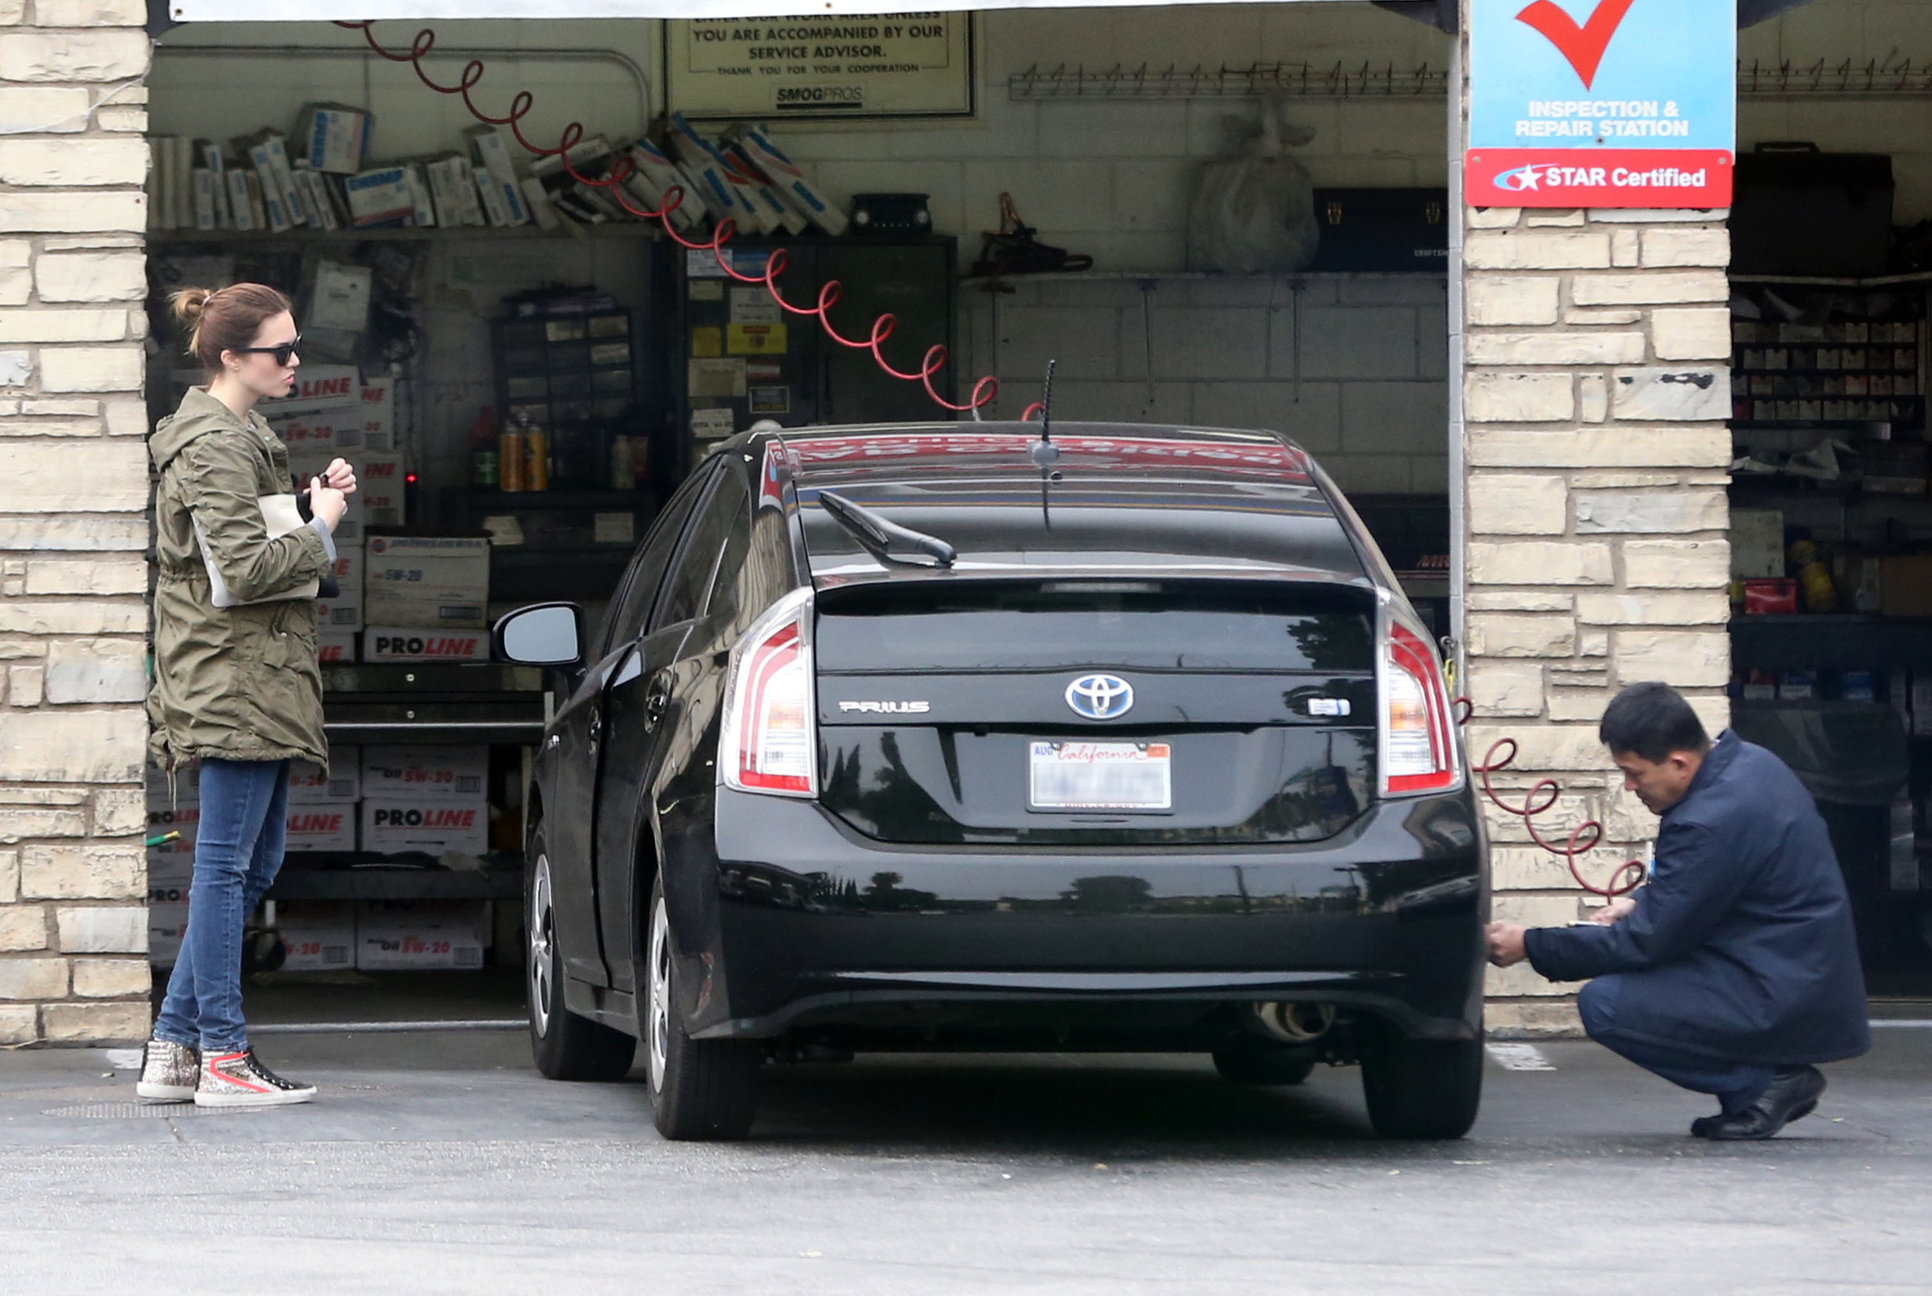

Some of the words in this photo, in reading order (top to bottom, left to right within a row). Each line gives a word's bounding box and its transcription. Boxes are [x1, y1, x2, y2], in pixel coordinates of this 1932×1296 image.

[693, 29, 727, 42] YOU
[732, 28, 761, 41] ARE
[766, 26, 879, 41] ACCOMPANIED
[884, 25, 904, 39] BY
[908, 24, 943, 38] OUR
[749, 46, 808, 60] SERVICE
[814, 44, 888, 59] ADVISOR.
[717, 66, 753, 76] THANK
[759, 66, 781, 75] YOU
[787, 65, 807, 74] FOR
[814, 64, 842, 74] YOUR
[847, 63, 919, 74] COOPERATION
[776, 87, 863, 102] SMOGPROS
[1528, 100, 1659, 118] INSPECTION
[1663, 100, 1680, 118] &
[1515, 120, 1593, 137] REPAIR
[1599, 119, 1690, 137] STATION
[1545, 166, 1607, 187] STAR
[1611, 167, 1706, 188] Certified
[375, 636, 478, 656] PROLINE
[838, 700, 931, 714] PRIUS
[1034, 746, 1054, 756] AUG
[1057, 743, 1148, 764] California
[374, 809, 477, 828] PROLINE
